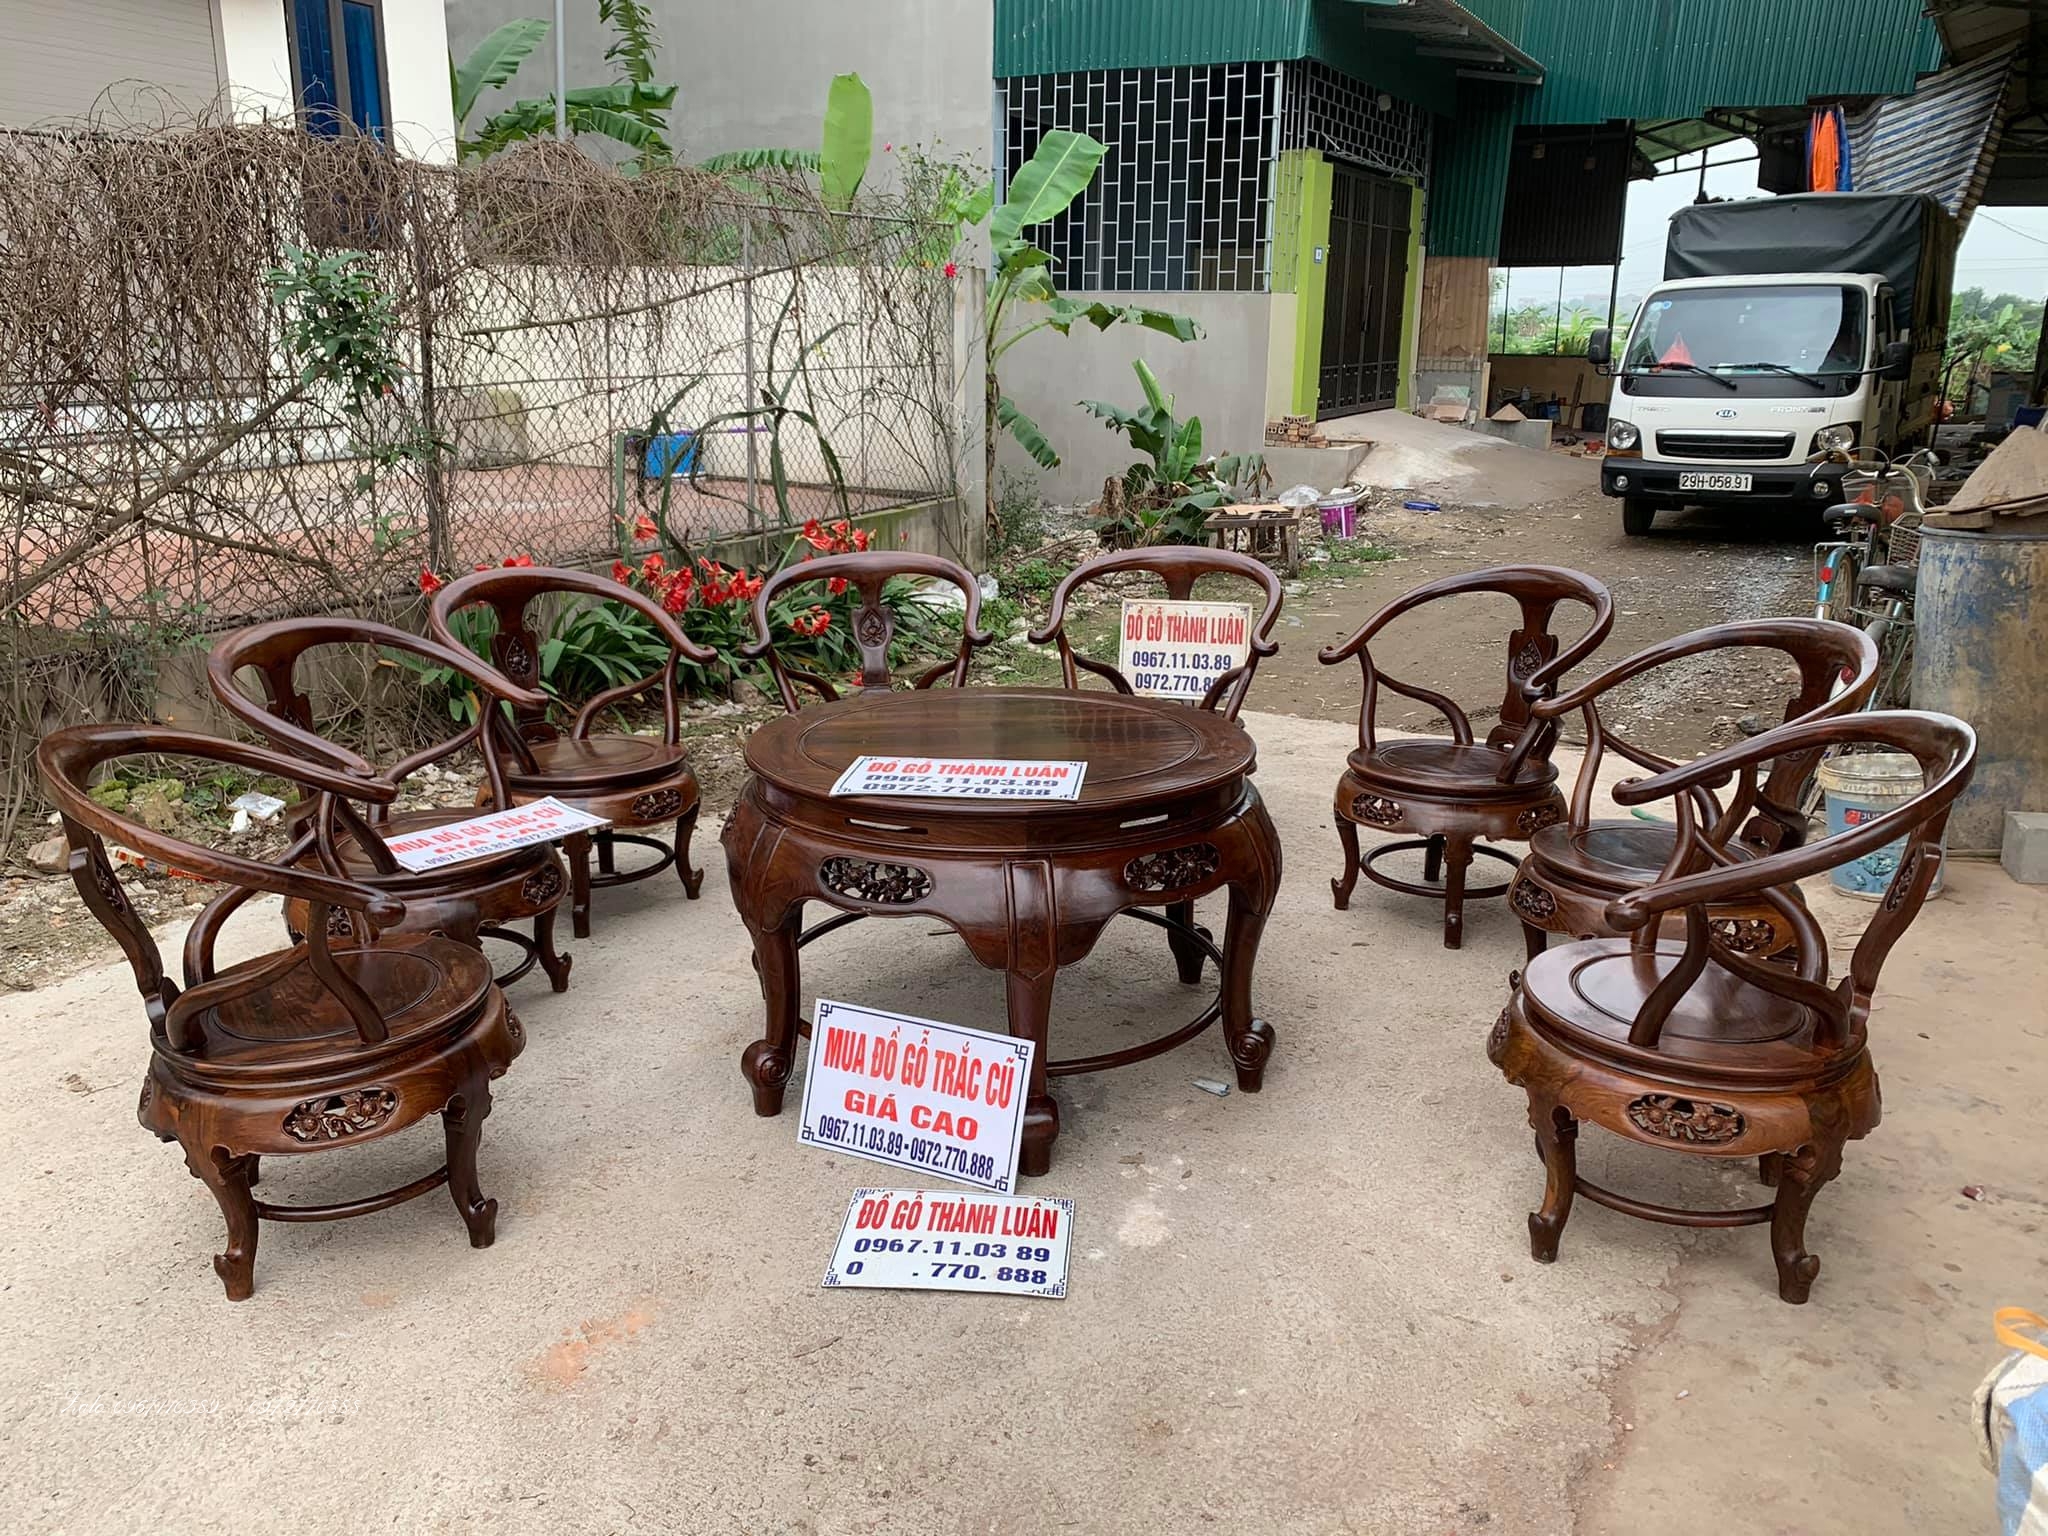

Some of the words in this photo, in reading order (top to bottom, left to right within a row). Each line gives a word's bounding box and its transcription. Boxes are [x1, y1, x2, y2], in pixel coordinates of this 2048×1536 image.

[1681, 474, 1749, 489] 29H-058.91
[1167, 610, 1207, 645] THÀNH
[1210, 612, 1244, 646] LUÂN
[1132, 651, 1232, 671] 0967.11.03.89
[1135, 672, 1229, 694] 0972.770.8
[938, 763, 1007, 777] THÀNH
[823, 1027, 866, 1075] MUA
[870, 1026, 900, 1082] ĐỒ
[901, 1030, 930, 1089] GỖ
[932, 1041, 982, 1101] TRẮC
[985, 1056, 1015, 1109] CŨ
[844, 1089, 898, 1123] GIÁ
[910, 1105, 978, 1142] CAO
[855, 1192, 893, 1229] ĐỒ
[890, 1190, 924, 1231] GỖ
[927, 1198, 999, 1235] THÀNH
[1001, 1203, 1059, 1240] LUÂN
